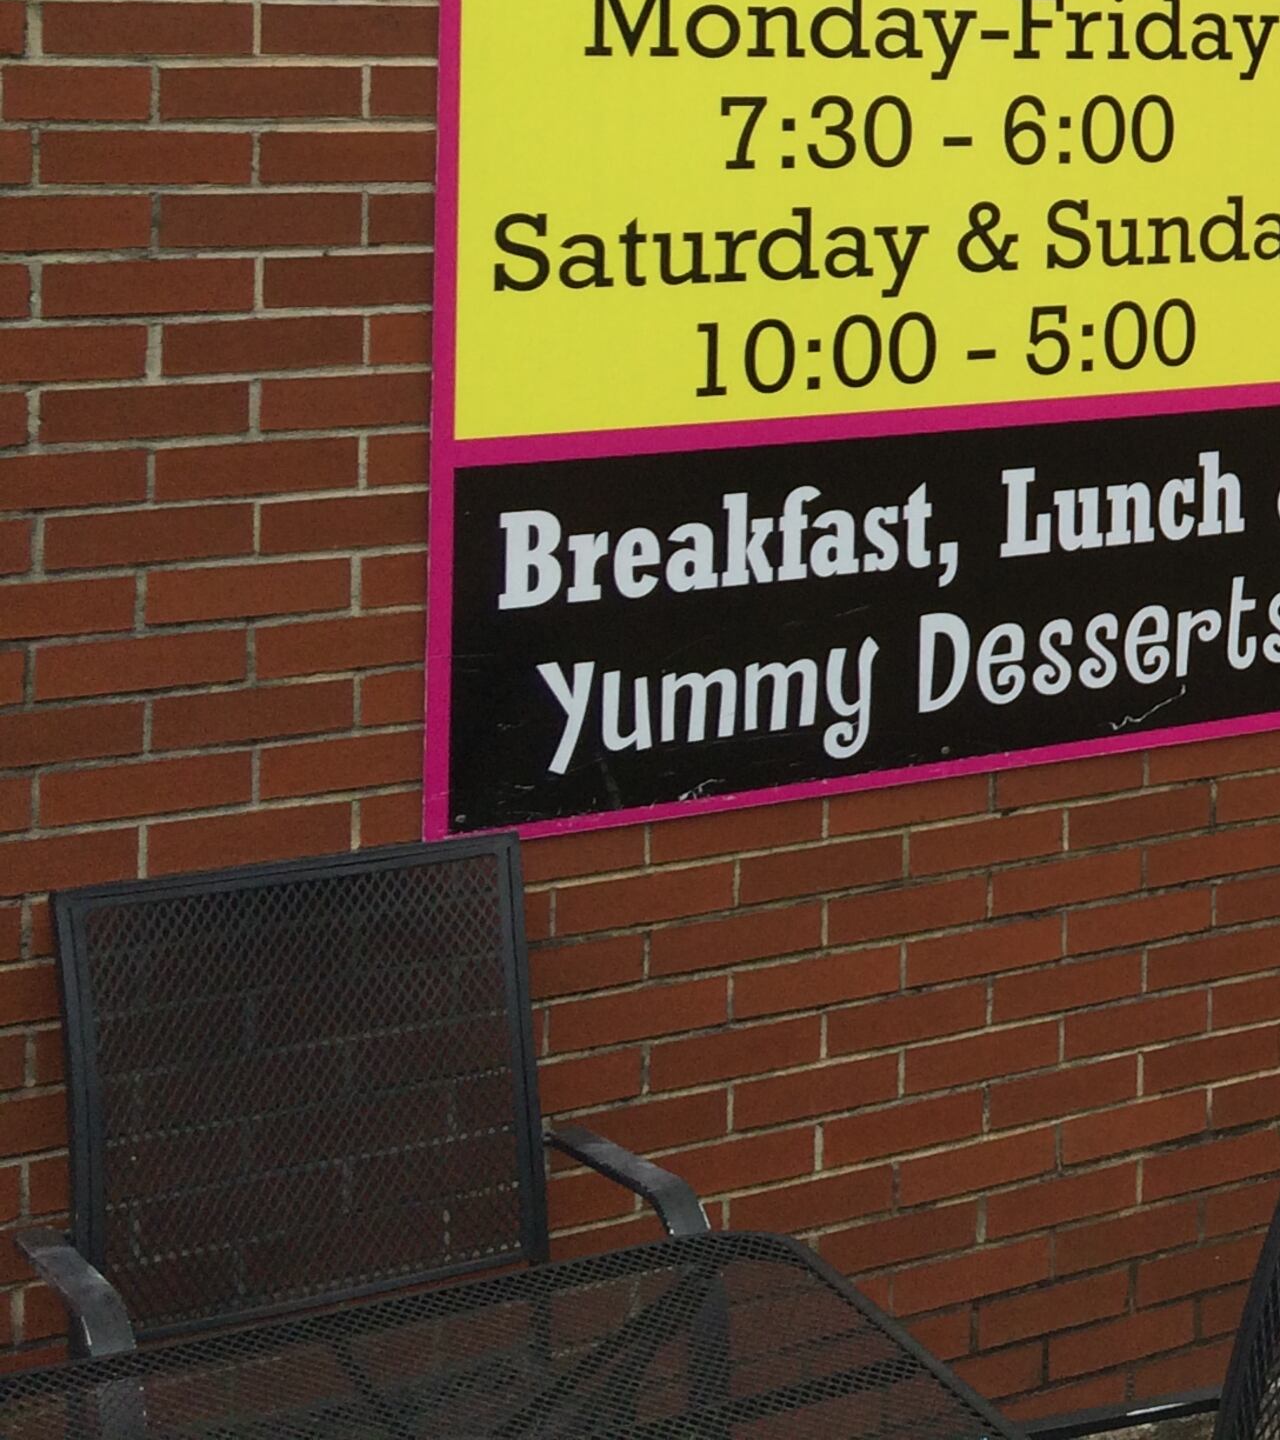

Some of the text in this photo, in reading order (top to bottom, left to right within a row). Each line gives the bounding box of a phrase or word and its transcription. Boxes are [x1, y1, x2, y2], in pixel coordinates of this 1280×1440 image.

[720, 95, 913, 170] 7:30
[1002, 94, 1176, 165] 6:00
[493, 207, 929, 298] Saturday
[957, 201, 1019, 273] &
[696, 312, 937, 397] 10:00
[1026, 298, 1197, 376] 5:00
[498, 482, 960, 611] Breakfast,
[999, 450, 1246, 558] Lunch
[536, 636, 880, 775] Yummy
